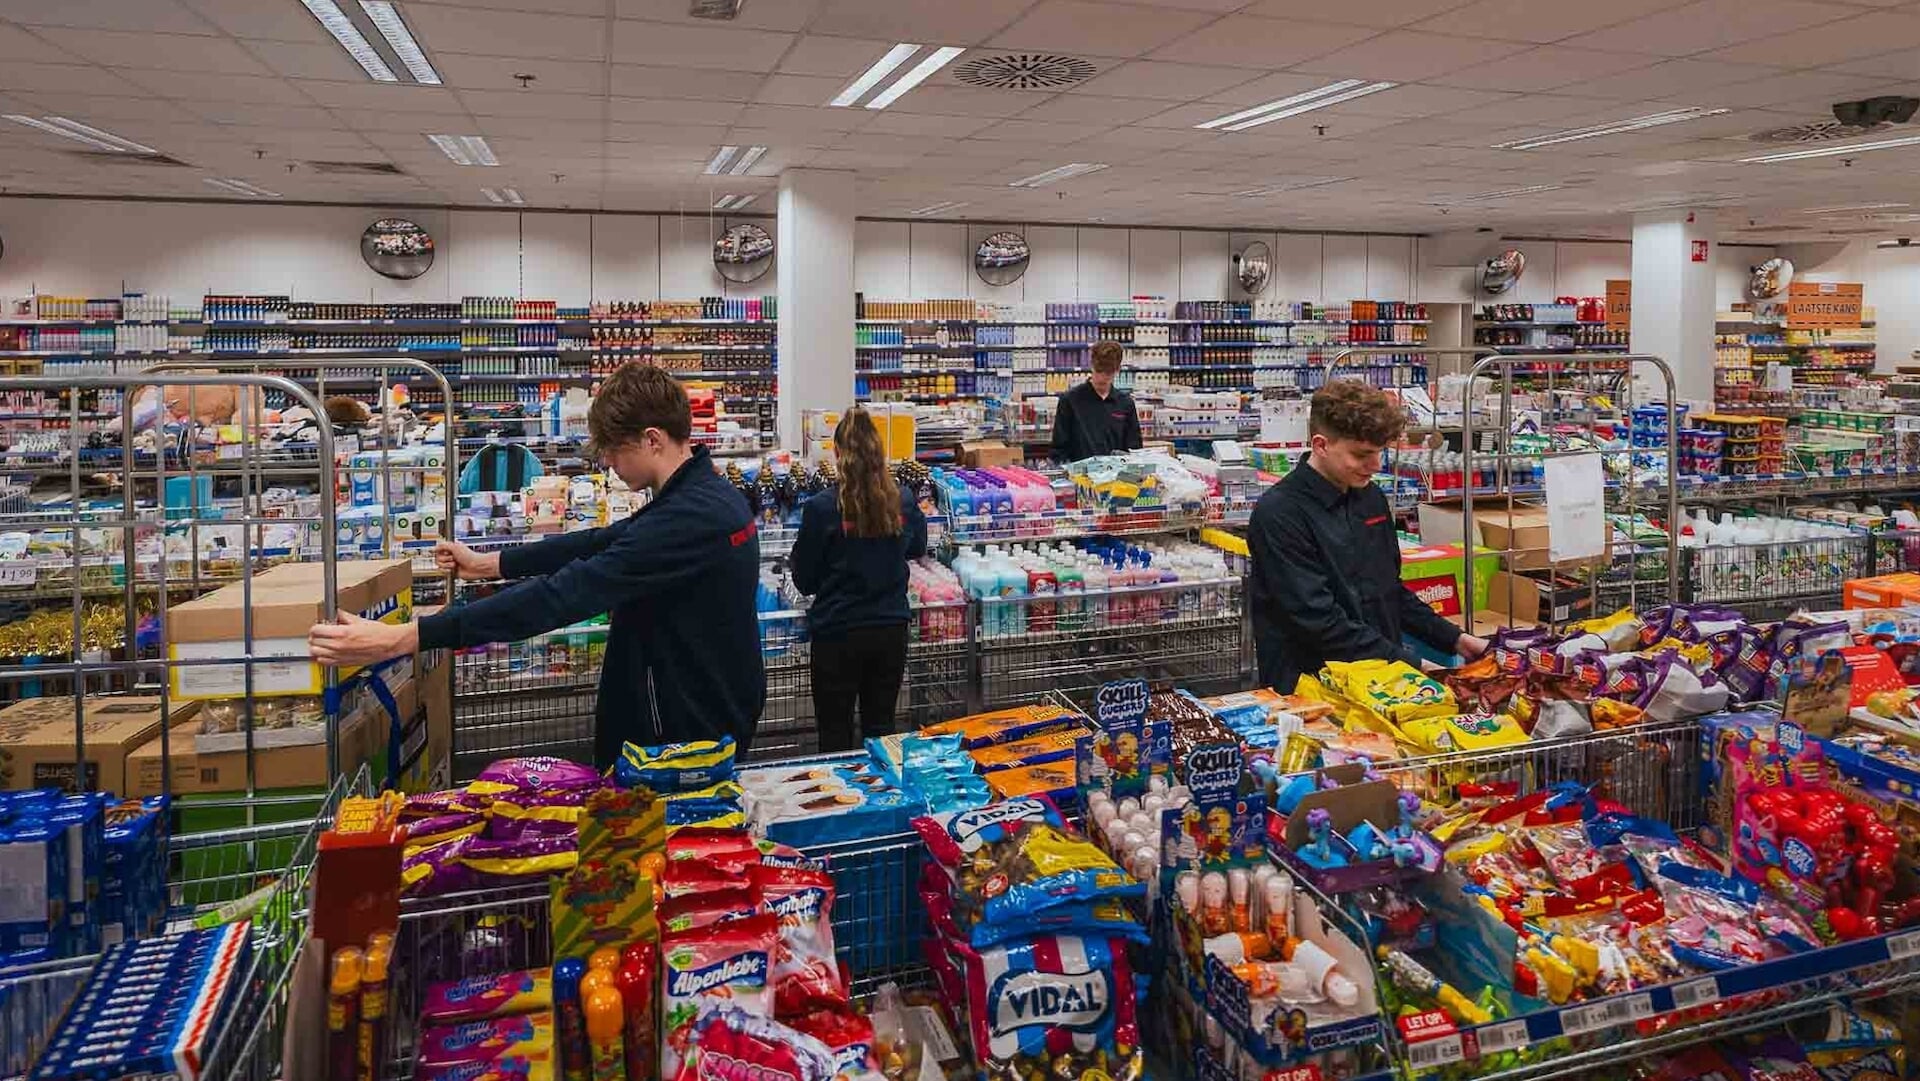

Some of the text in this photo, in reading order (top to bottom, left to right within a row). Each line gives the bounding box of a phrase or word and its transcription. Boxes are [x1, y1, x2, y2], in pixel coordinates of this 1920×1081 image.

[1793, 303, 1832, 314] LAATSTE
[1099, 682, 1147, 701] SKULL
[1099, 702, 1146, 717] SUCKERS
[1189, 749, 1241, 770] SKULL
[1190, 770, 1241, 787] SUCKERS
[960, 800, 1042, 827] VIDAL
[673, 953, 760, 998] Alpenliebe
[1006, 982, 1101, 1019] VIDAL
[1405, 1011, 1446, 1029] LET OP!
